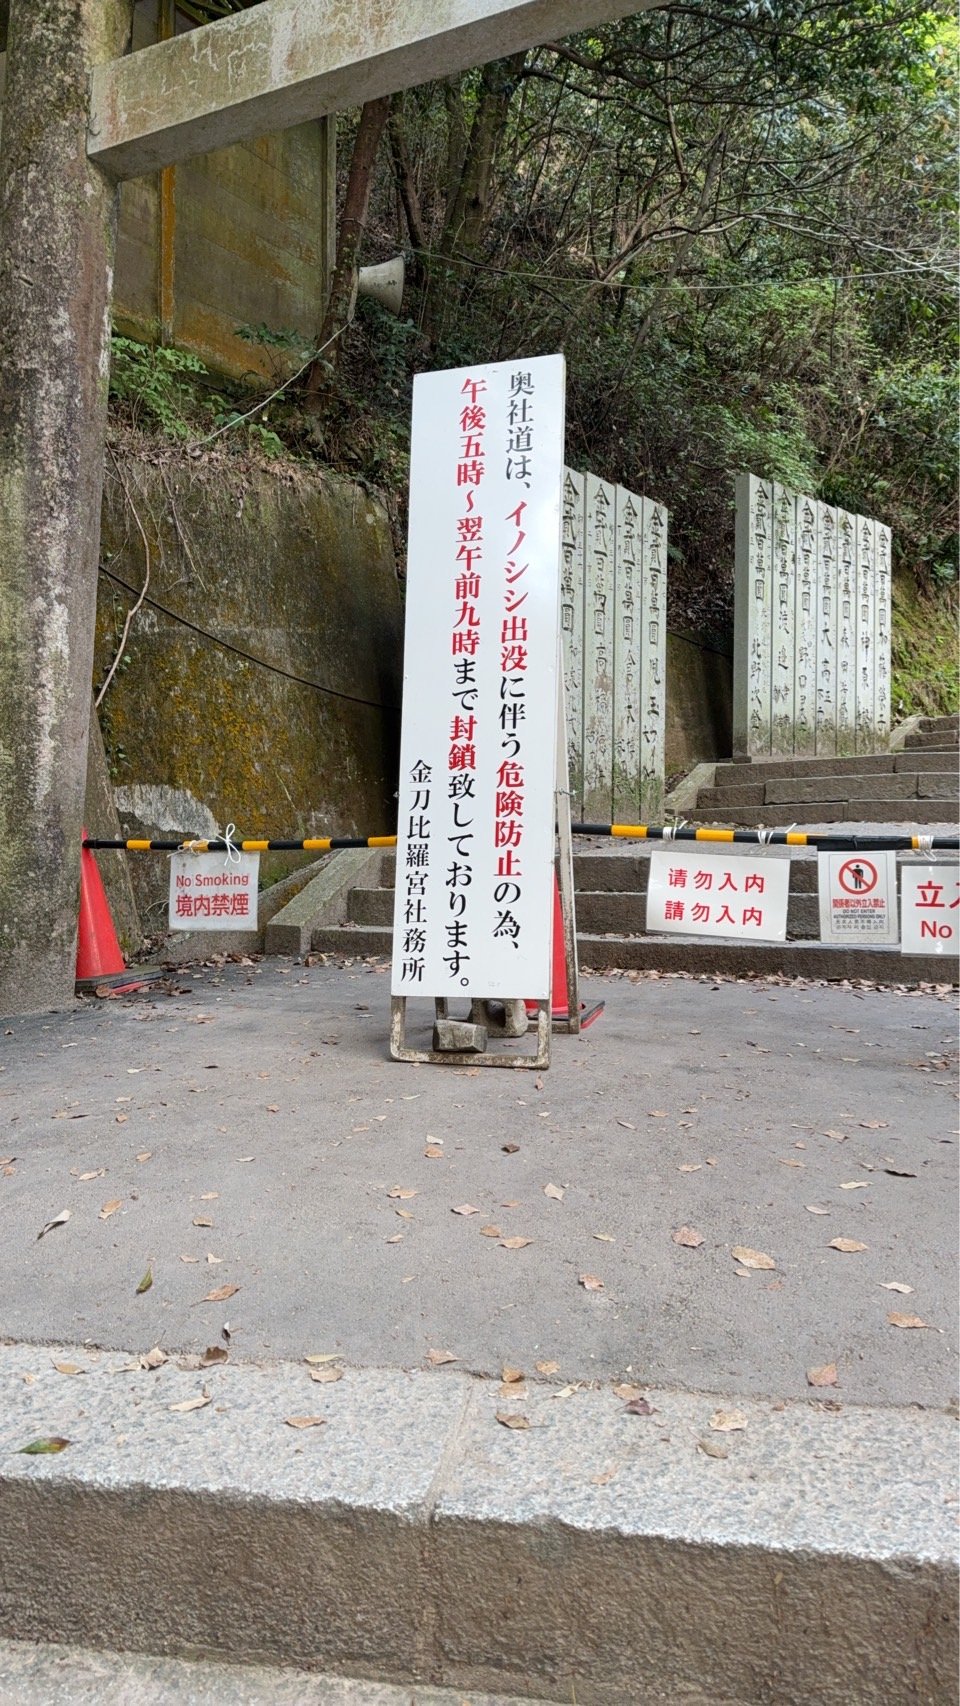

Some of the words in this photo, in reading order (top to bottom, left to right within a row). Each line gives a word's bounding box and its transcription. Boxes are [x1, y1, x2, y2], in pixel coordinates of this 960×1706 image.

[176, 875, 191, 887] No
[195, 873, 249, 886] Smoking
[401, 759, 432, 982] 金刀比羅宮社務所
[668, 868, 765, 894] 请勿入内
[176, 893, 249, 917] 境内禁煙
[664, 900, 763, 927] 請勿入内
[921, 920, 952, 938] No
